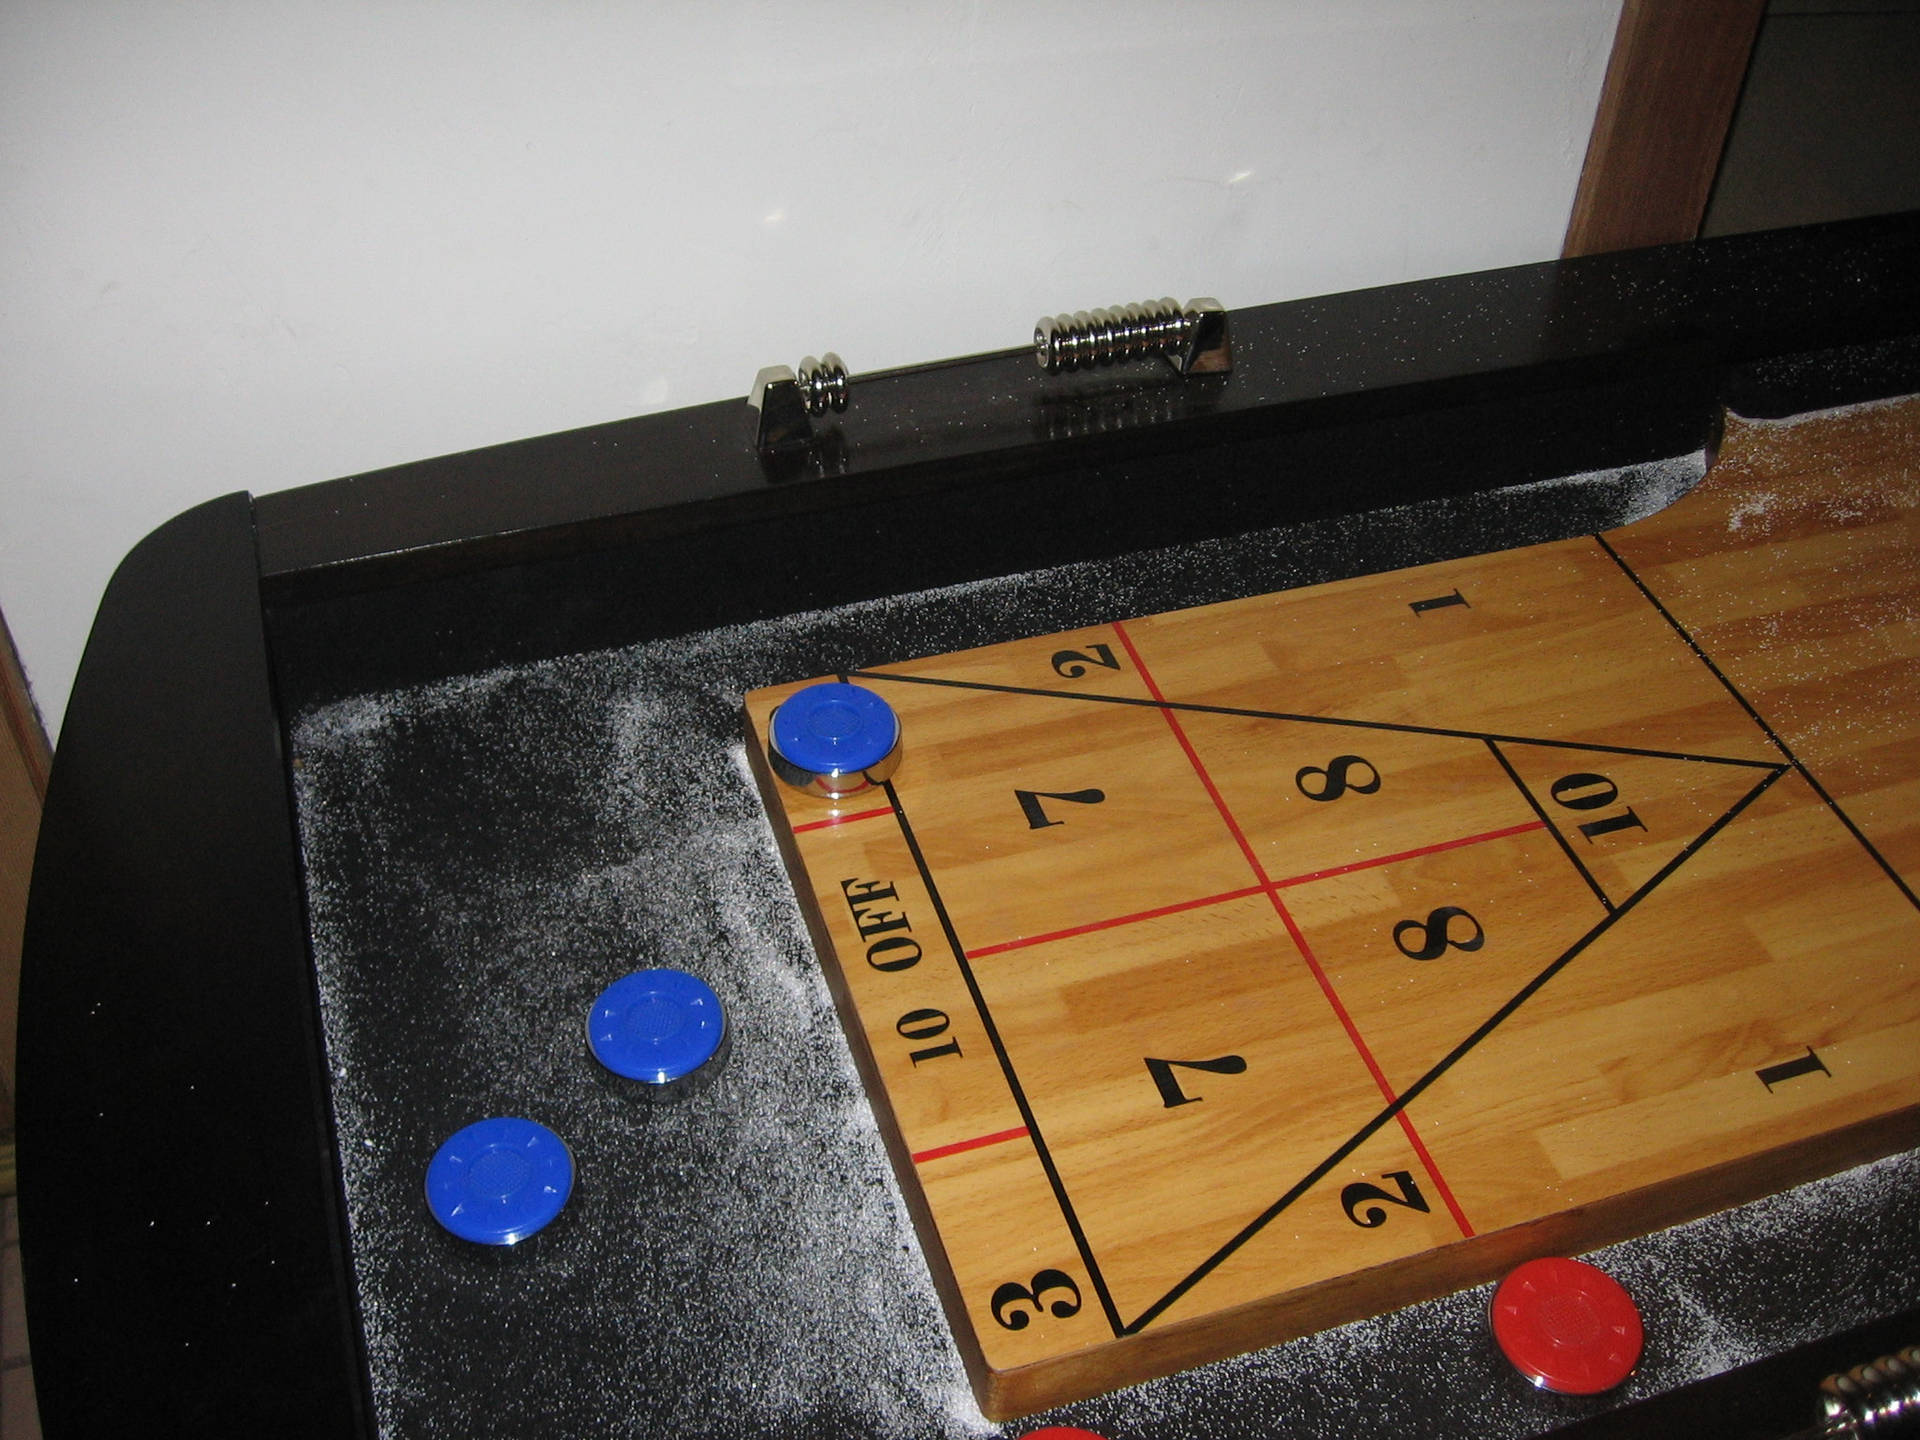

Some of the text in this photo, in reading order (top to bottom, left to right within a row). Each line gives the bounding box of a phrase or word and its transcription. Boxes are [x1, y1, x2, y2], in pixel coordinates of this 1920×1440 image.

[1409, 588, 1470, 617] 1
[1052, 644, 1121, 678] 2
[1296, 755, 1381, 801] 8
[1015, 789, 1105, 829] 7
[1551, 773, 1648, 844] 10
[1393, 907, 1484, 960] 8
[841, 877, 963, 1067] 10 OFF
[1144, 1055, 1247, 1108] 7
[1756, 1046, 1831, 1093] 1
[1341, 1171, 1430, 1228] 2
[991, 1269, 1081, 1331] 3
